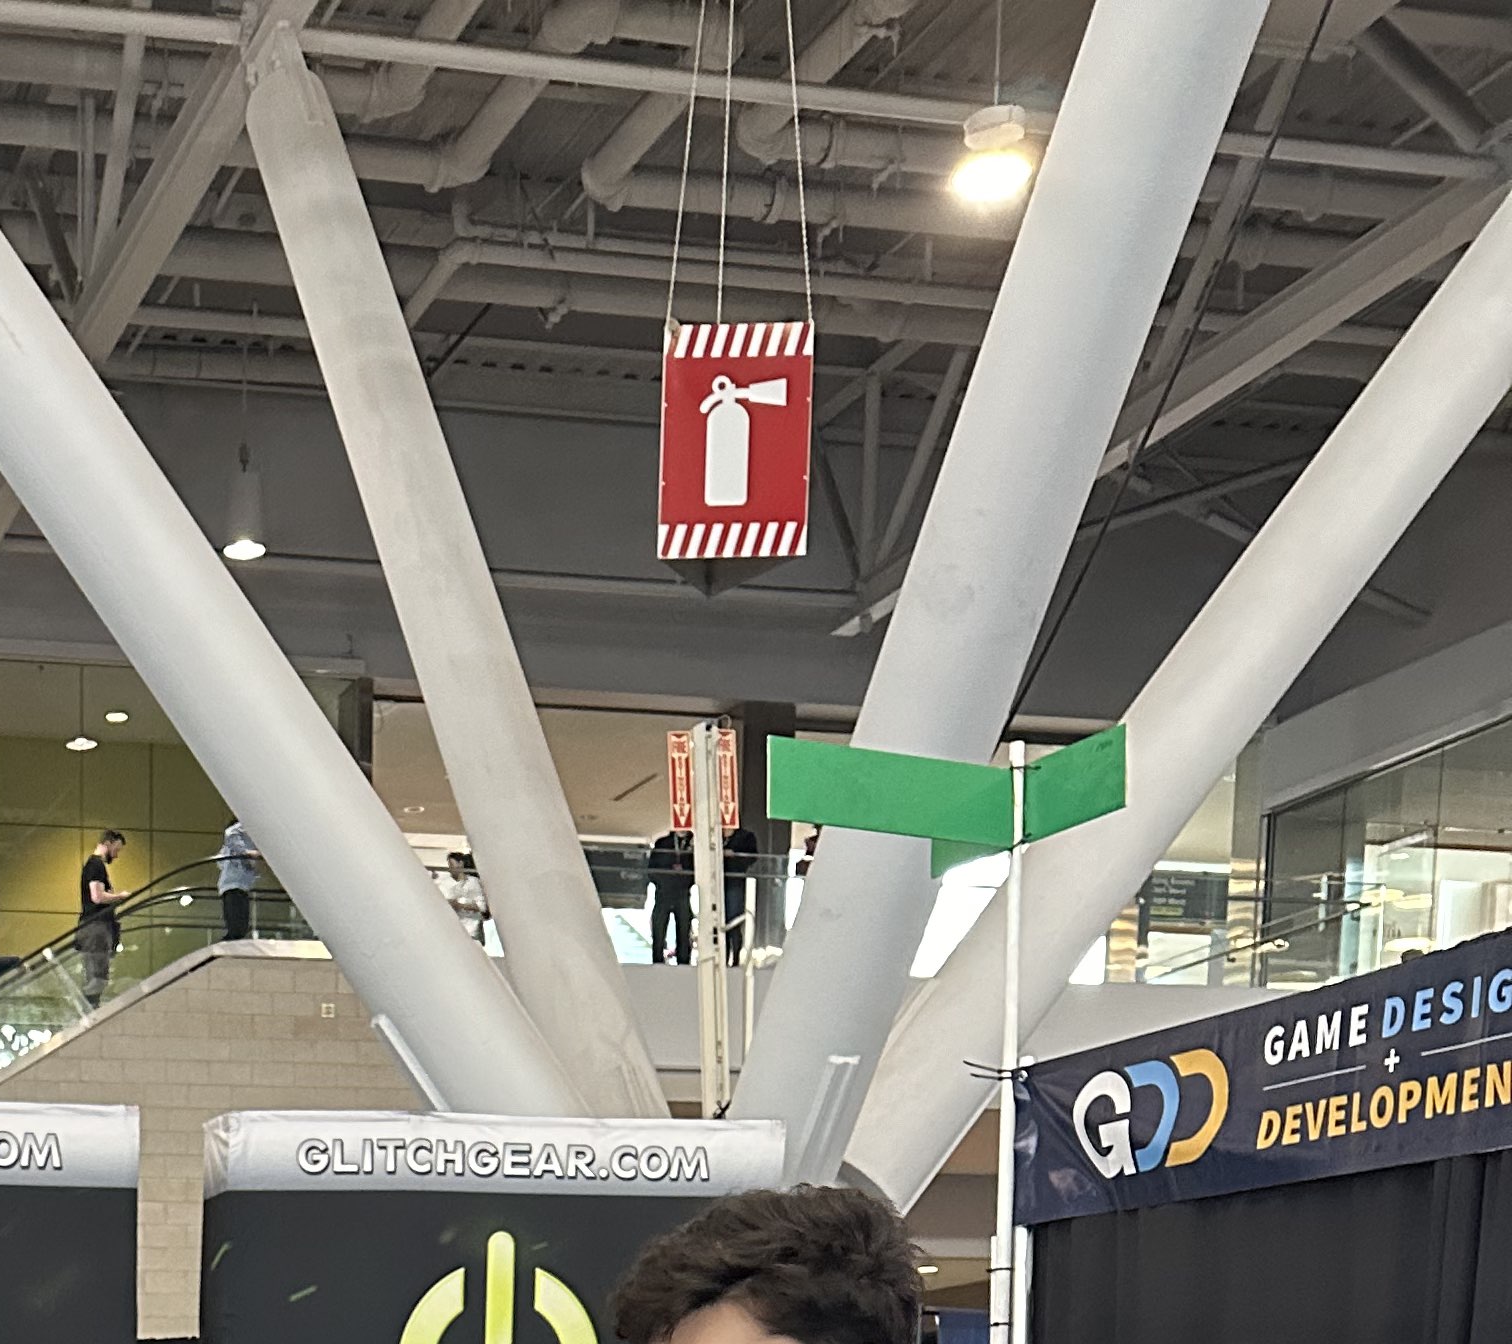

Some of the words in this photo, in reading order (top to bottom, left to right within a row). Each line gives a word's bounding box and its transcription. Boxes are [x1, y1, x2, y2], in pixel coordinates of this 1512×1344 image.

[1263, 1004, 1370, 1066] GAME
[1381, 967, 1512, 1039] DESIG
[1256, 1068, 1512, 1150] DEVELOPMEN
[296, 1138, 709, 1180] GLITCHGEAR.COM
